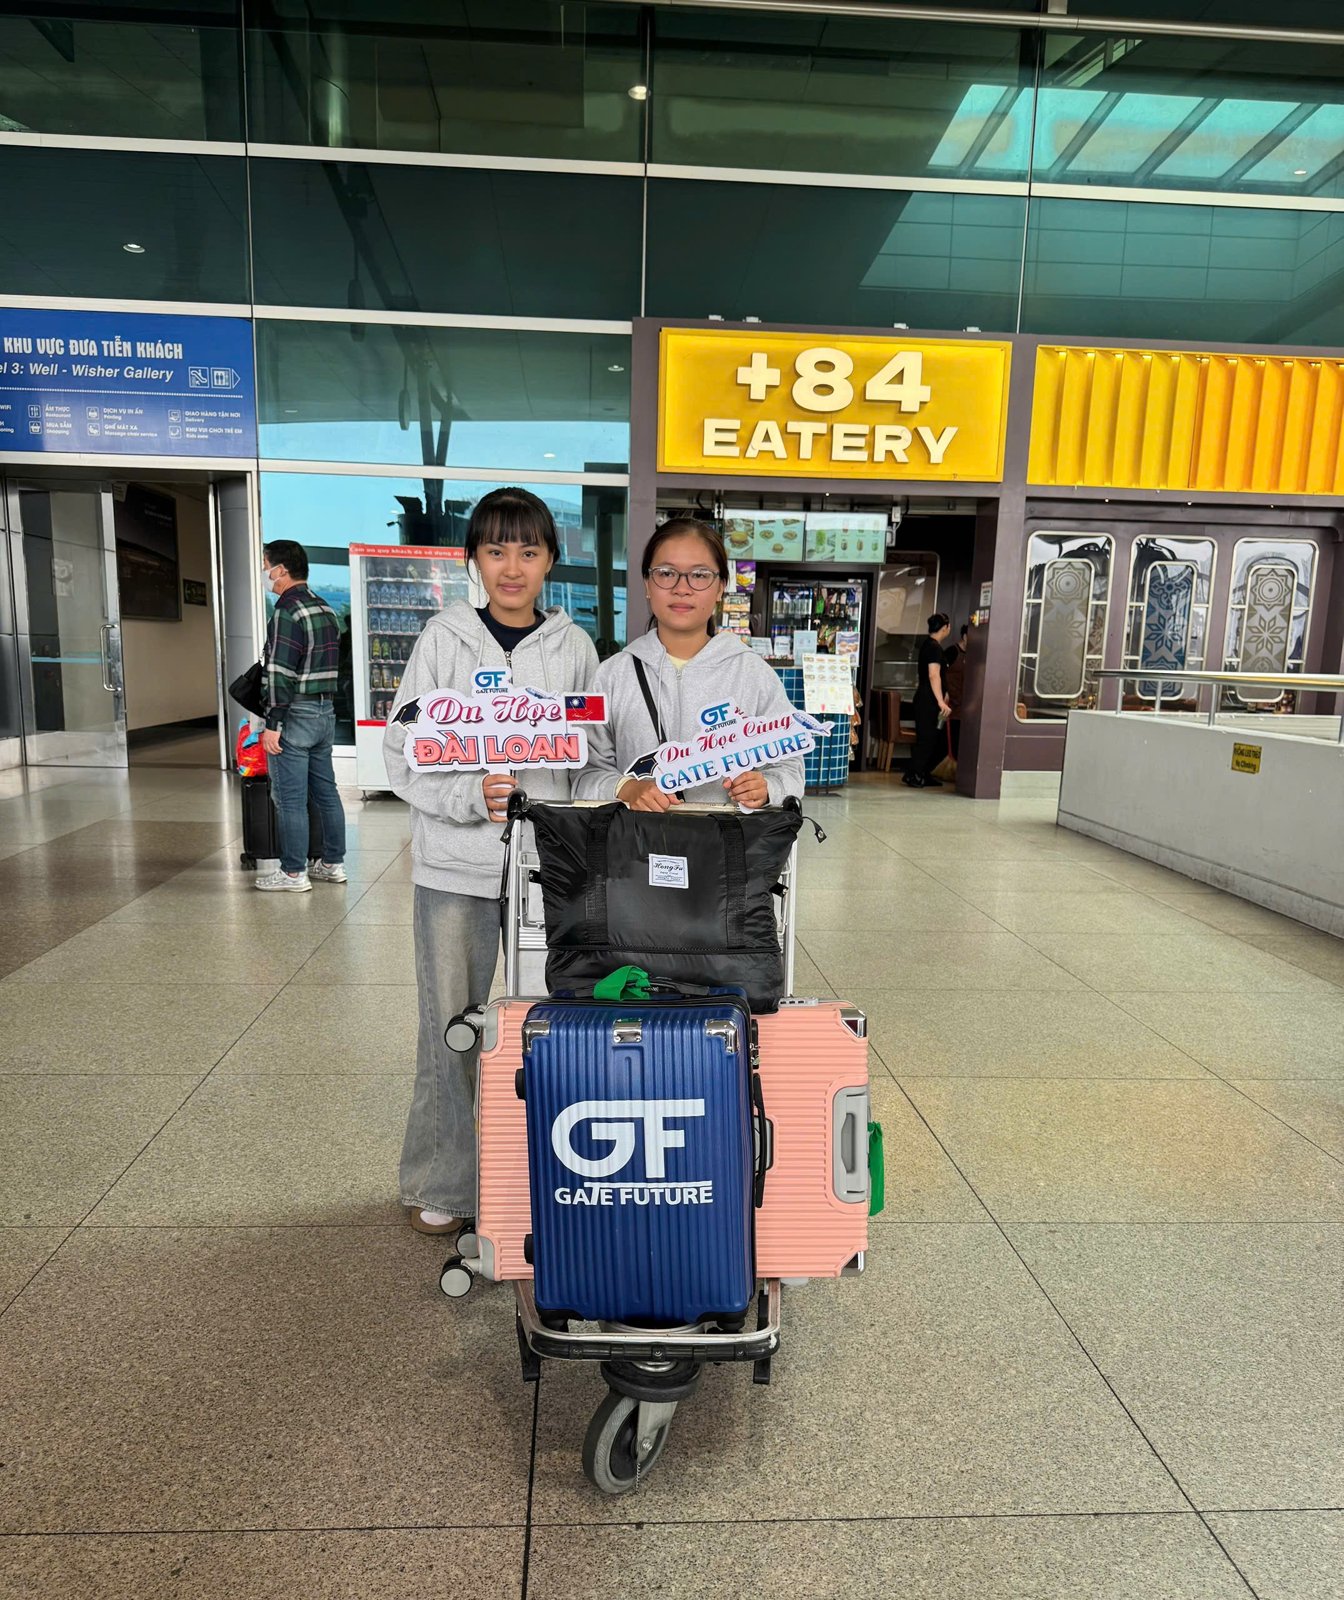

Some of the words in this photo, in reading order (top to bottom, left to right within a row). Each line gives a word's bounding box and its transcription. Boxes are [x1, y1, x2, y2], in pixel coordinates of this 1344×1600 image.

[4, 336, 32, 354] KHU
[36, 338, 64, 358] VỰC
[69, 338, 98, 356] ĐƯA
[102, 336, 132, 357] TIỄN
[137, 340, 183, 360] KHÁCH
[11, 362, 24, 374] 3:
[30, 362, 58, 376] Well
[72, 364, 120, 378] Wisher
[124, 366, 174, 382] Gallery
[736, 346, 931, 413] +84
[702, 418, 959, 464] EATERY
[475, 671, 506, 688] GF
[427, 697, 483, 724] Du
[492, 696, 562, 727] Học
[700, 702, 730, 726] GF
[717, 718, 737, 730] FUTURE
[413, 730, 479, 766] ĐÀI
[484, 734, 581, 764] LOAN
[660, 746, 691, 763] Du
[697, 732, 738, 754] Học
[743, 713, 792, 738] Cùng
[660, 760, 718, 790] GATE
[721, 732, 810, 772] FUTURE
[551, 1098, 705, 1178] GF
[554, 1182, 614, 1206] GATE
[620, 1186, 713, 1205] FUTURE
